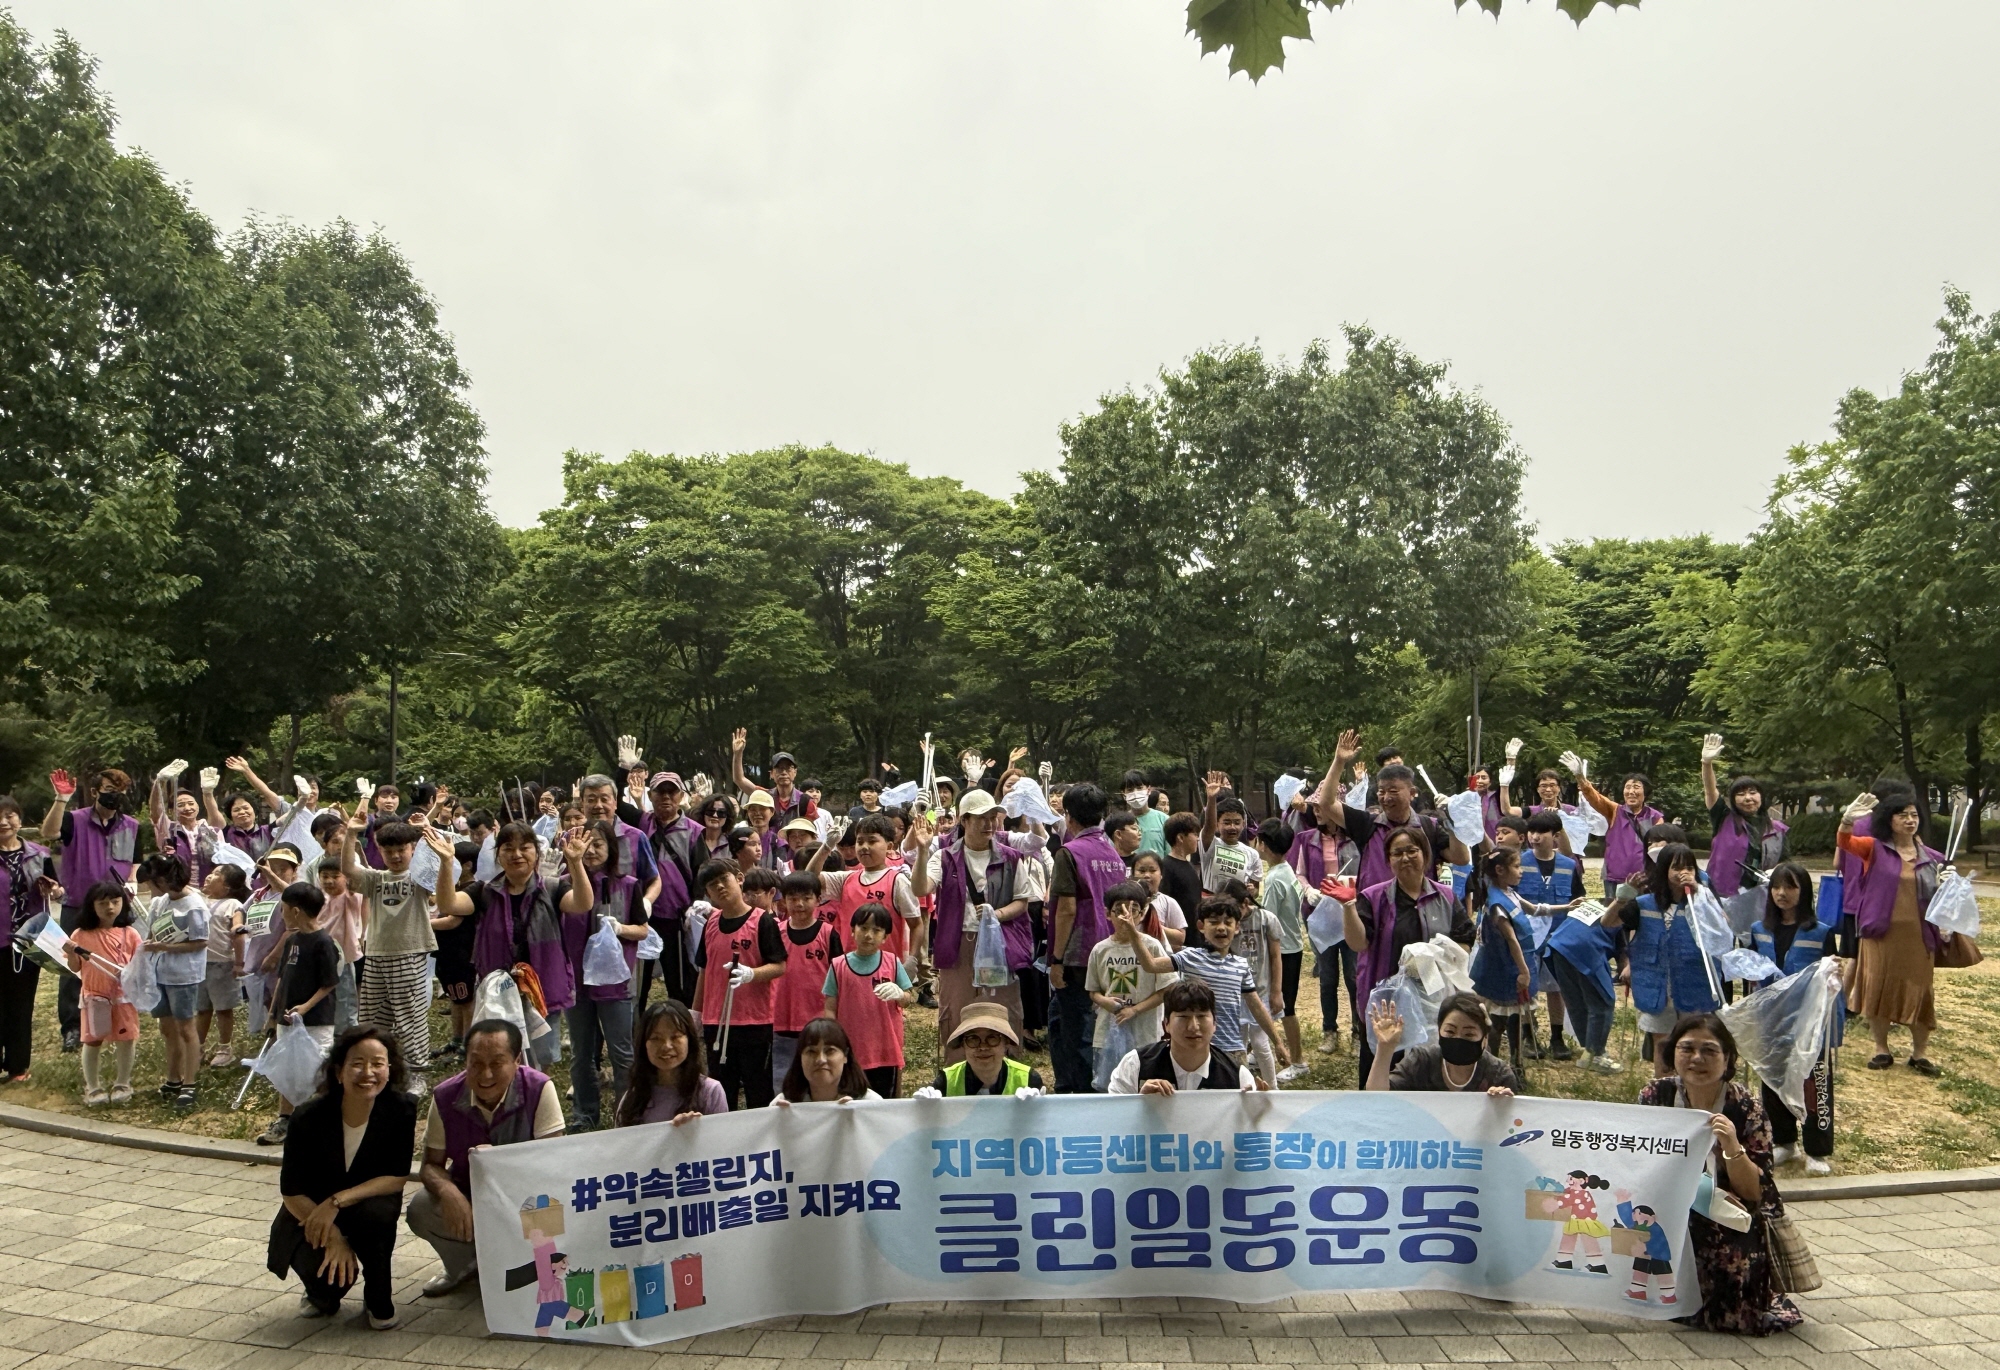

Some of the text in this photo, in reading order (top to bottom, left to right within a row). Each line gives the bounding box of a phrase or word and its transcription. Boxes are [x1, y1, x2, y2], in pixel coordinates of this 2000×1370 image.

[447, 981, 469, 1001] 10
[932, 1132, 1483, 1178] 지역아동센터와 통장이 함께하는
[1550, 1129, 1689, 1158] 일동행정복지센터
[571, 1149, 794, 1212] #약속챌린지,
[609, 1179, 901, 1248] 분리배출일 지켜요
[935, 1184, 1483, 1274] 클린일동운동
